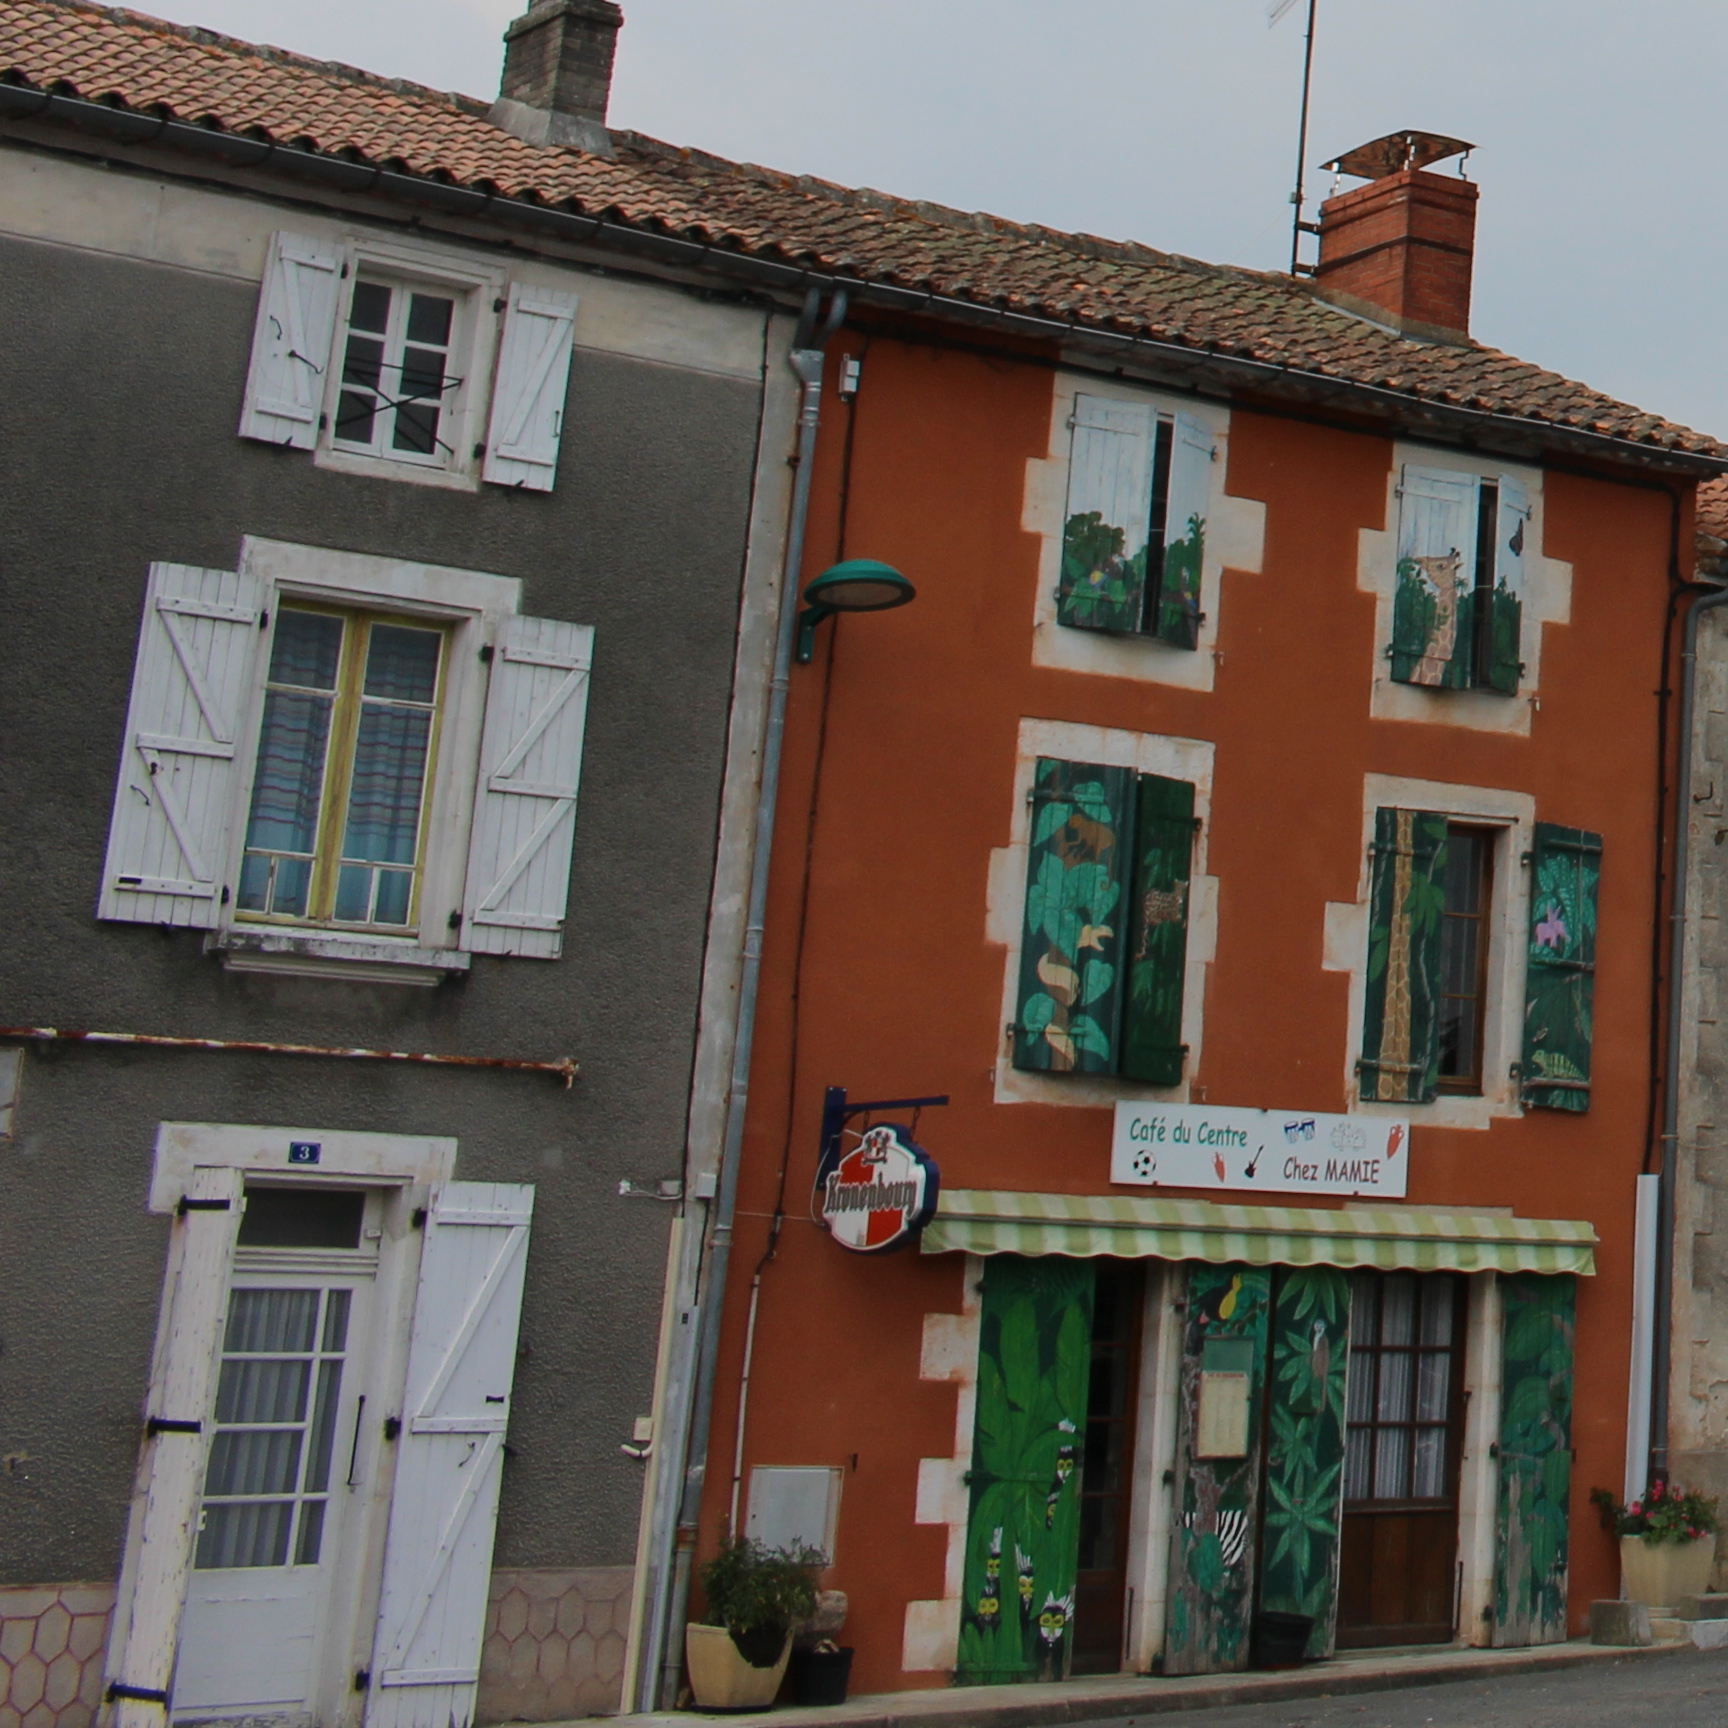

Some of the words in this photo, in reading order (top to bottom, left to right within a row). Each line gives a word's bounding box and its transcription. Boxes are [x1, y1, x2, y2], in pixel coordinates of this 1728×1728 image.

[1130, 1116, 1166, 1142] Café
[1173, 1120, 1191, 1143] du
[1197, 1121, 1248, 1148] Centre
[299, 1146, 310, 1159] 3
[1283, 1157, 1318, 1181] Chez
[1324, 1159, 1381, 1184] MAMIE
[825, 1172, 917, 1217] Kronenbourg
